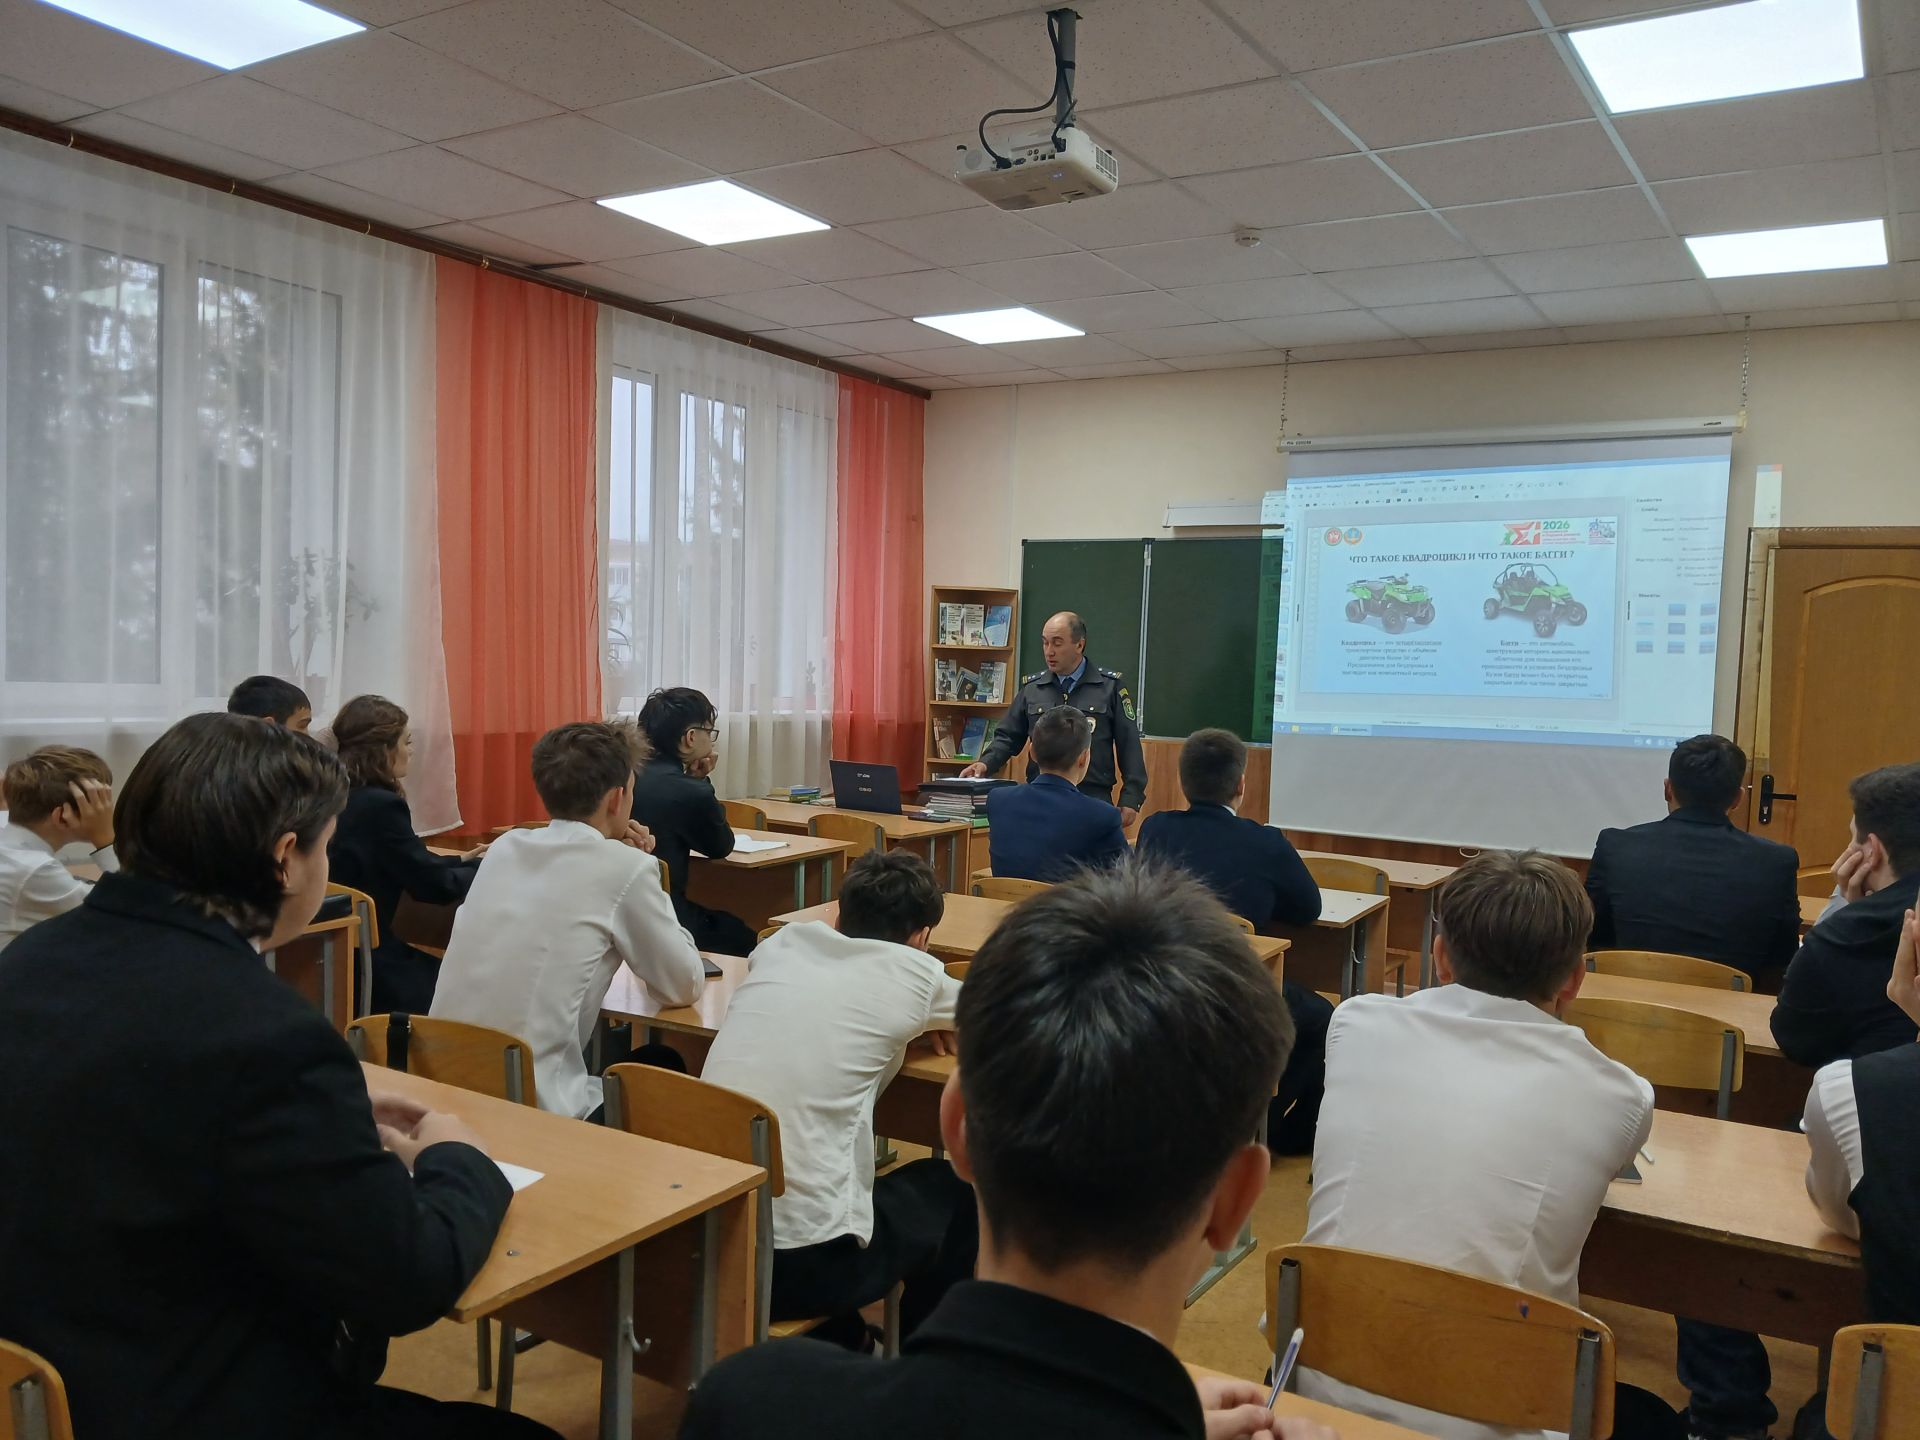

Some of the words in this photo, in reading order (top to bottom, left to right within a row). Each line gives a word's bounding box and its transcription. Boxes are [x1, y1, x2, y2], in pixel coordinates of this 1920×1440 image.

[1543, 520, 1570, 530] 2026
[1370, 554, 1400, 563] ТАКОЕ
[1402, 553, 1466, 563] КВАДРОЦИКЛ
[1468, 552, 1476, 561] И
[1478, 552, 1498, 561] ЧТО
[1500, 551, 1533, 560] ТАКОЕ
[1534, 550, 1568, 560] БАГГИ
[1569, 550, 1575, 559] ?
